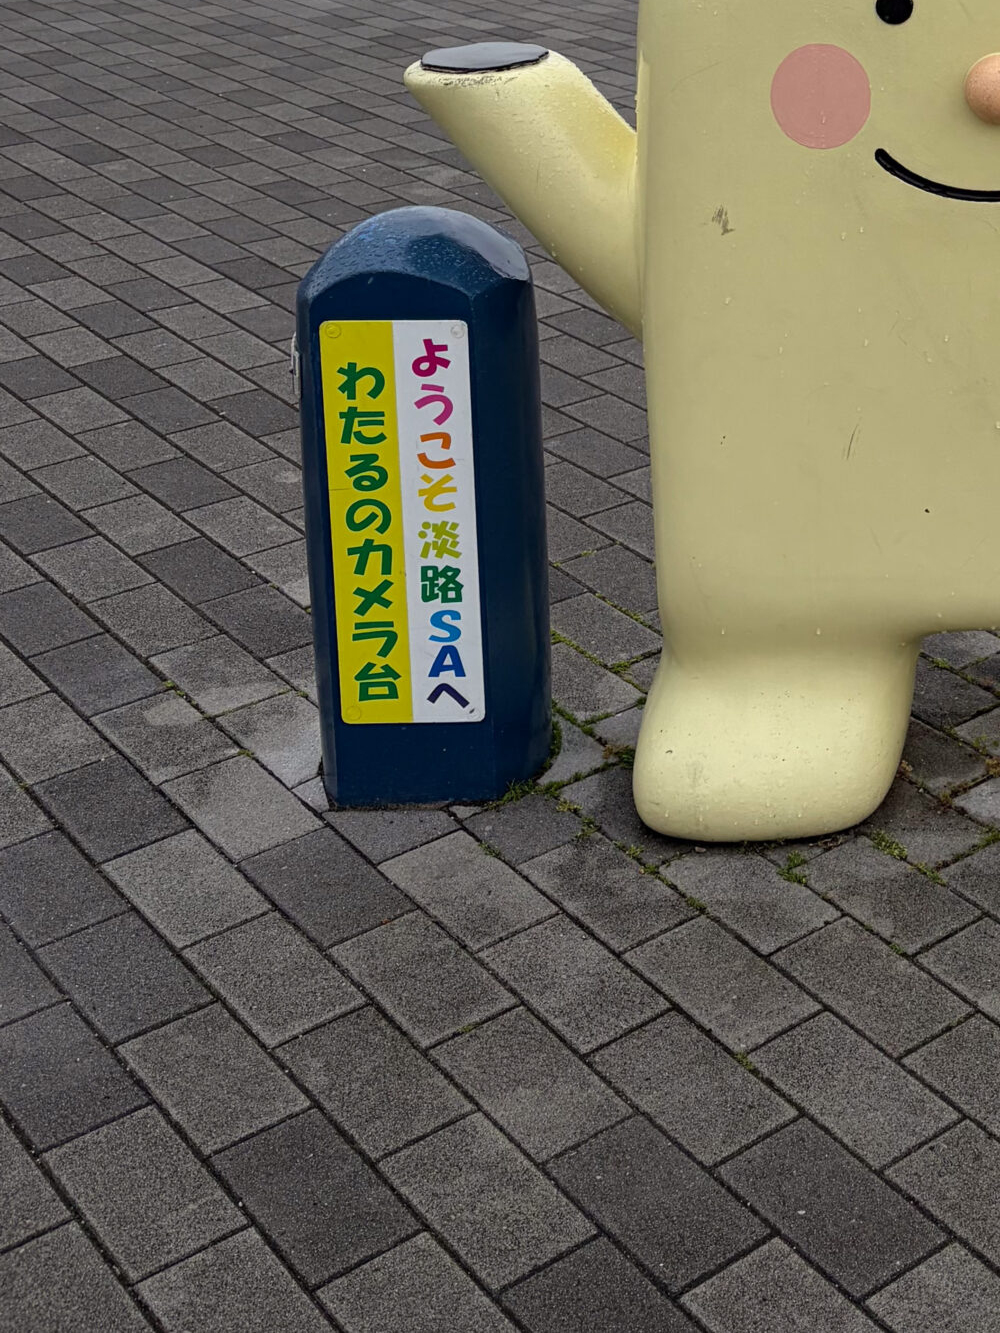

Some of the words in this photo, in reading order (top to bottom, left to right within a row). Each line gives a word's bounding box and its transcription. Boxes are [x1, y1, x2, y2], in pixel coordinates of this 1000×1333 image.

[336, 361, 402, 703] わたるのカメラ台
